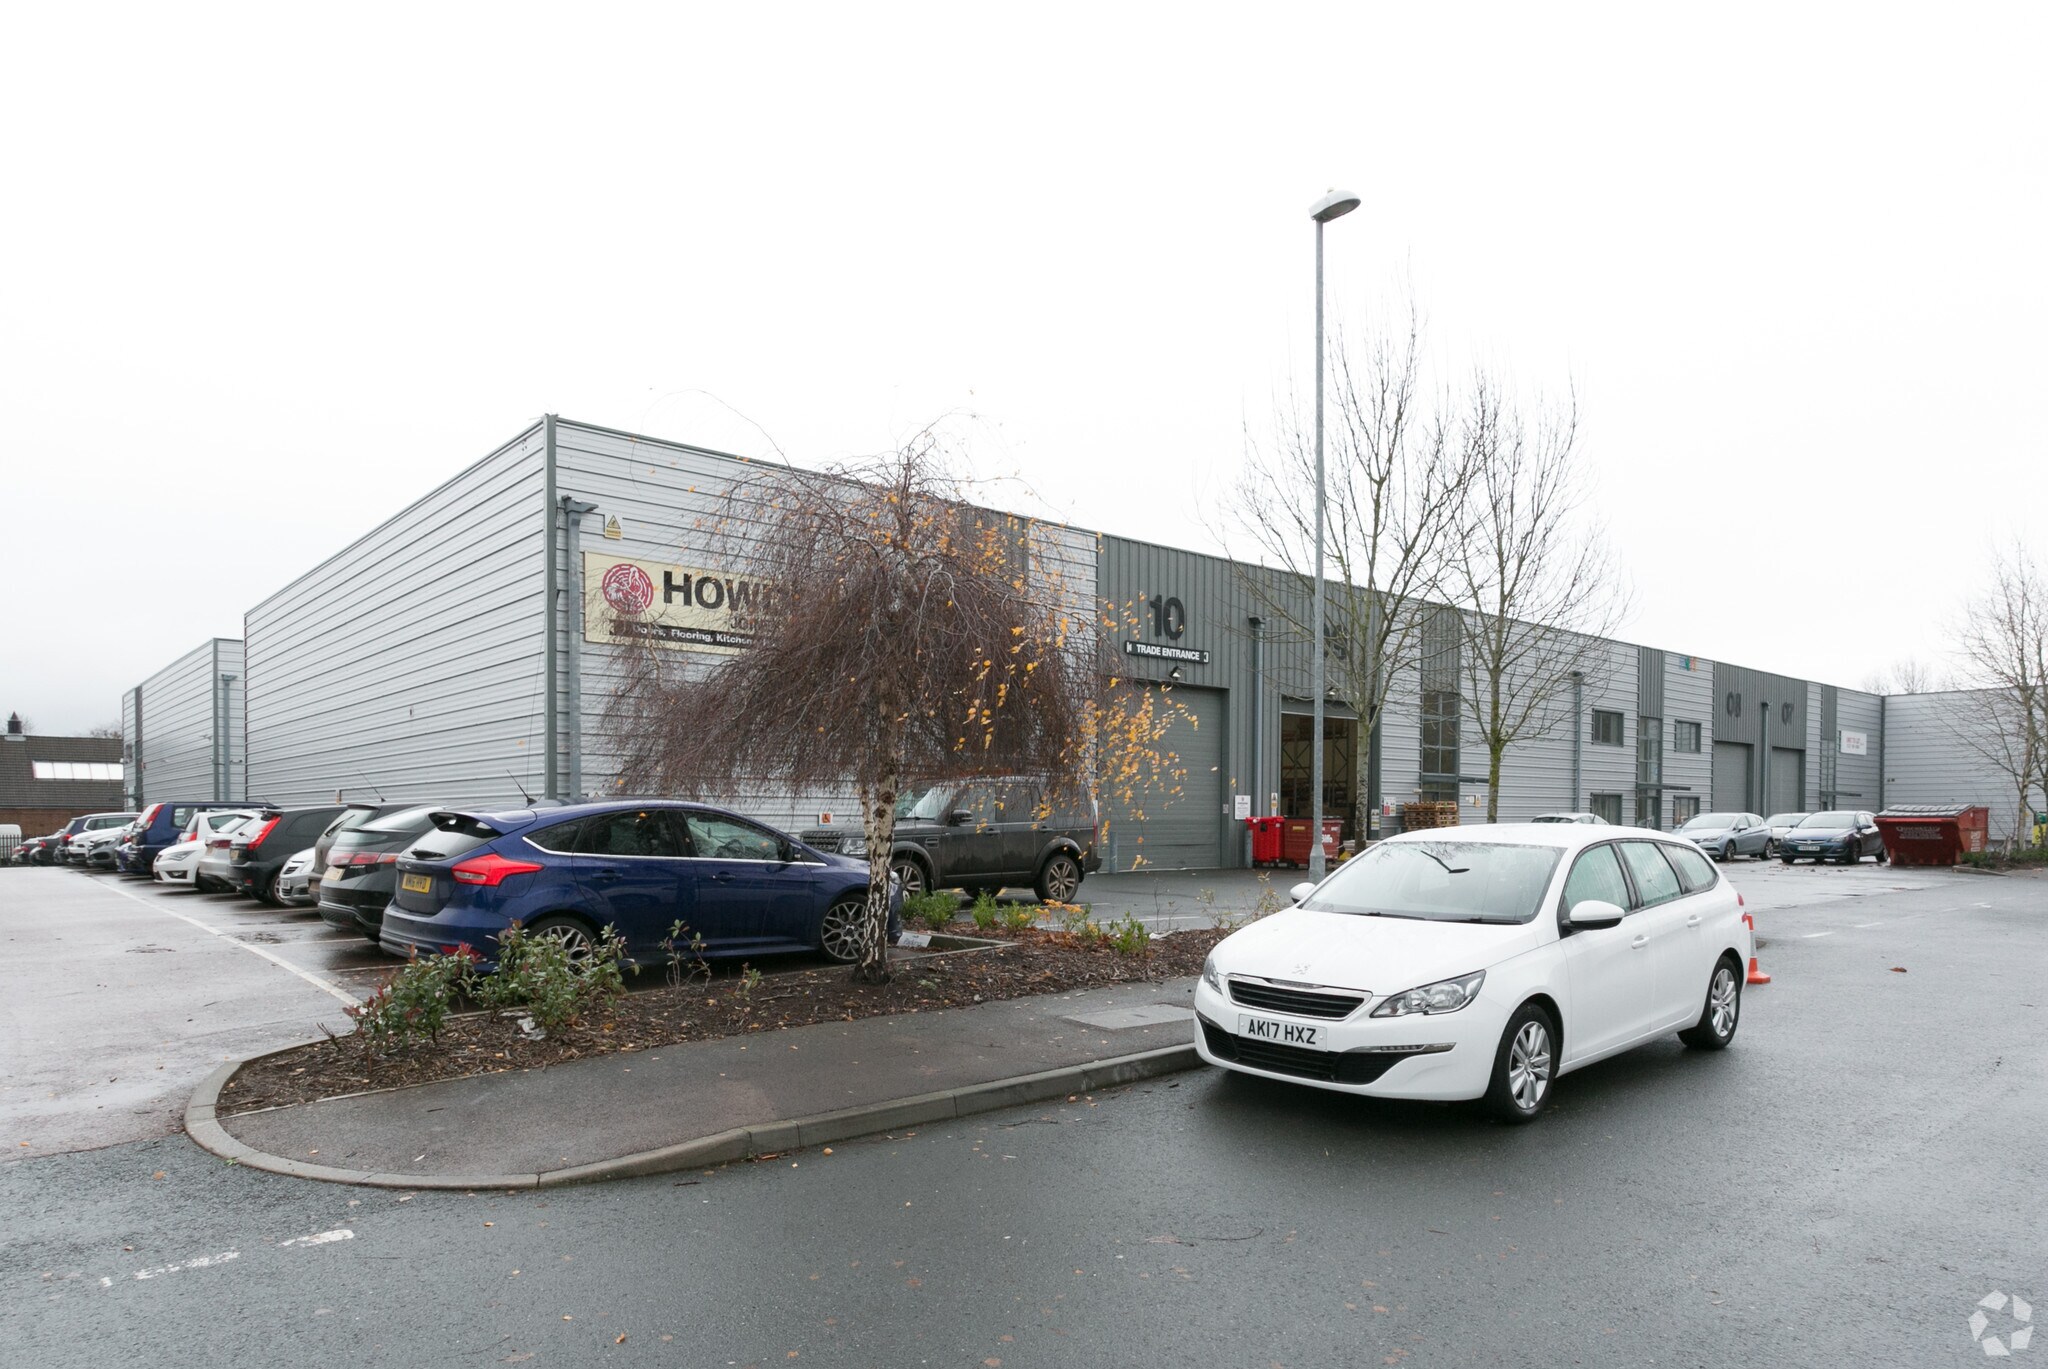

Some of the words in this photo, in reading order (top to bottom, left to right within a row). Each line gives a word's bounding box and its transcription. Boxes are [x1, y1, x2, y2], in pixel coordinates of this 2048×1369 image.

[1150, 594, 1185, 640] 10
[632, 624, 667, 637] Dors,
[671, 626, 714, 643] Flooring,
[716, 633, 755, 645] Kitchen
[1136, 643, 1161, 656] TRADE
[1162, 647, 1200, 661] ENTRANCE
[1248, 1018, 1280, 1039] AK17
[1284, 1024, 1317, 1045] HXZ
